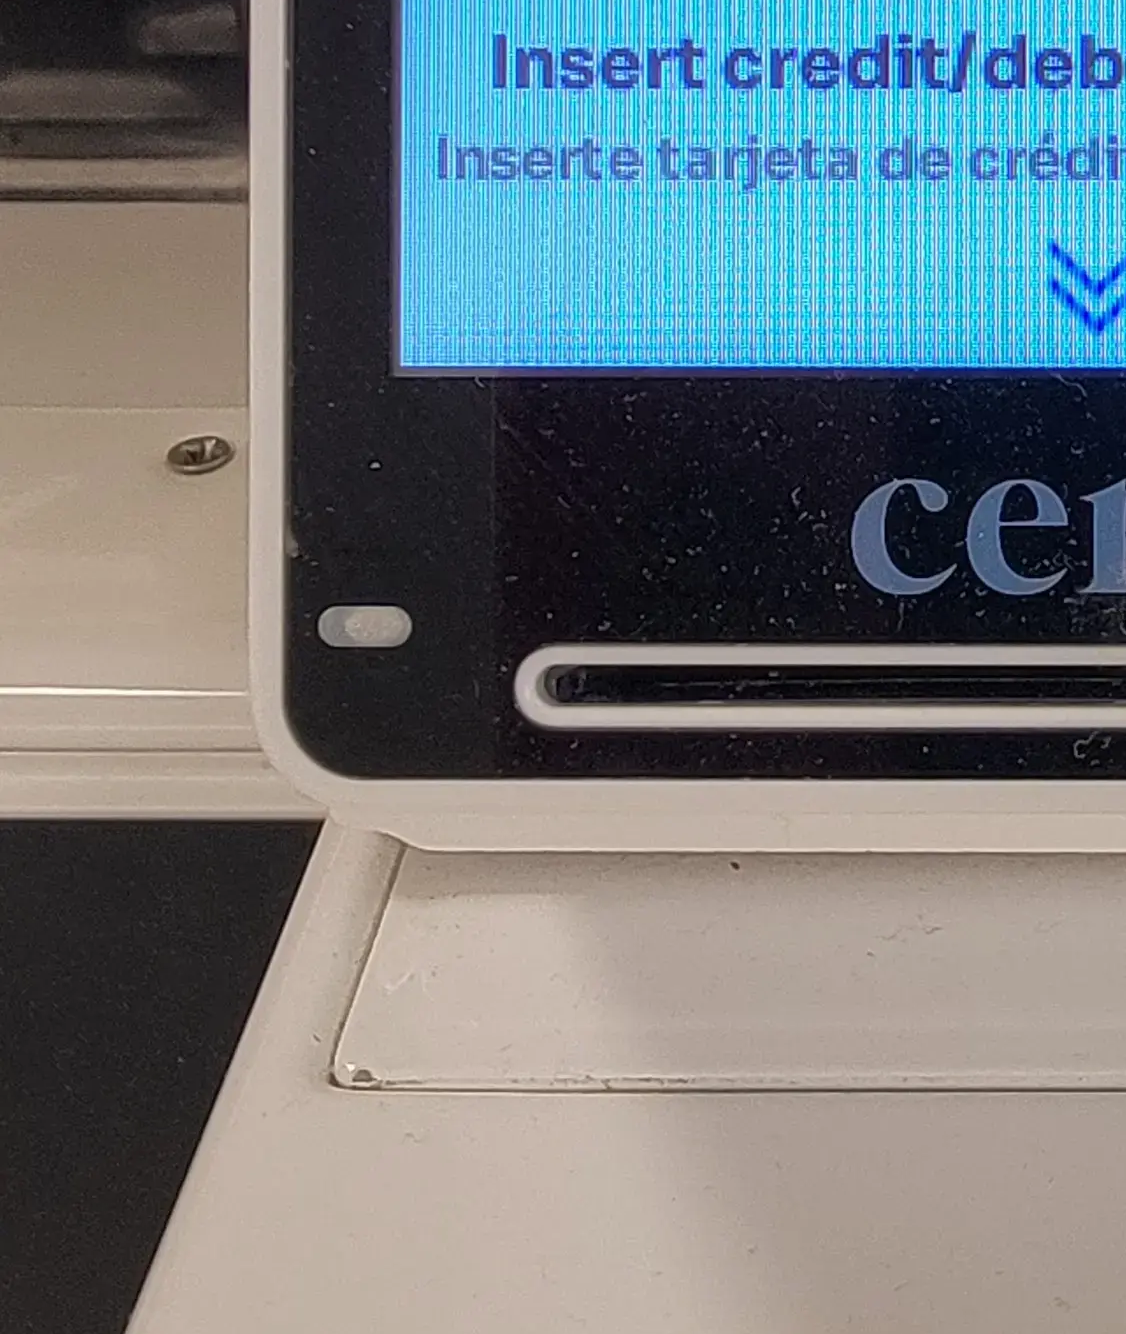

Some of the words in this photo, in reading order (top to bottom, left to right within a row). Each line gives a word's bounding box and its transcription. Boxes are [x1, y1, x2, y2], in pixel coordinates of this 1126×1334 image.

[492, 33, 706, 90] Insert
[437, 134, 644, 181] Inserte
[657, 134, 858, 191] tarjeta
[878, 134, 951, 181] de
